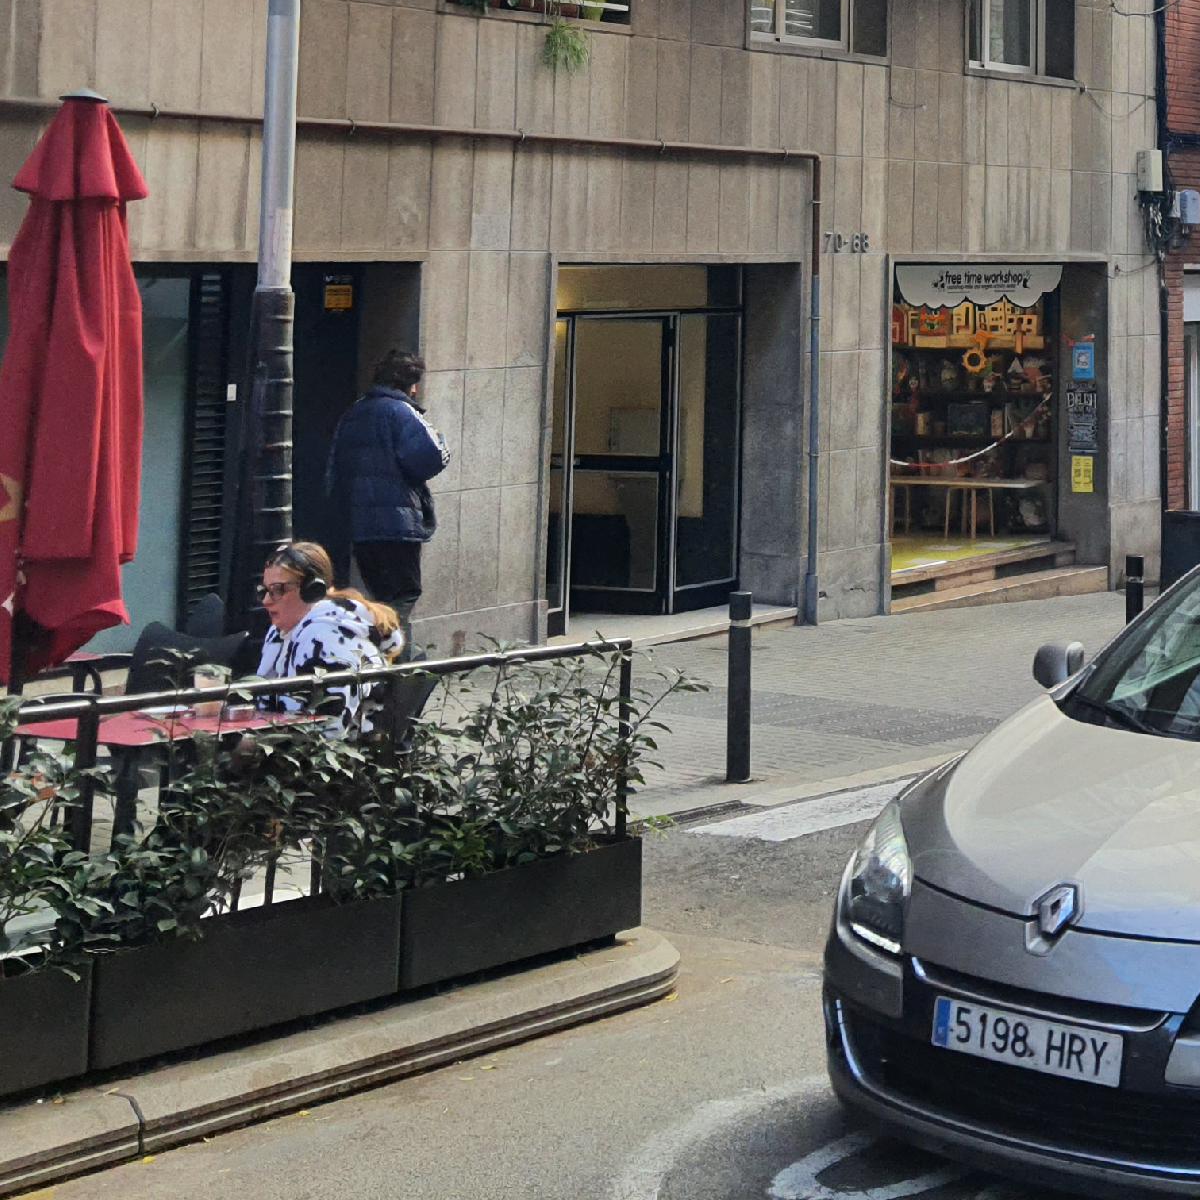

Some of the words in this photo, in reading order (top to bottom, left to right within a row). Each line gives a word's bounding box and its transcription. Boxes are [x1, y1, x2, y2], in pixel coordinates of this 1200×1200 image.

[945, 271, 962, 285] free
[964, 271, 982, 285] time
[984, 270, 1023, 286] workshop
[956, 1006, 1030, 1057] 5198
[1046, 1029, 1108, 1076] HRY
